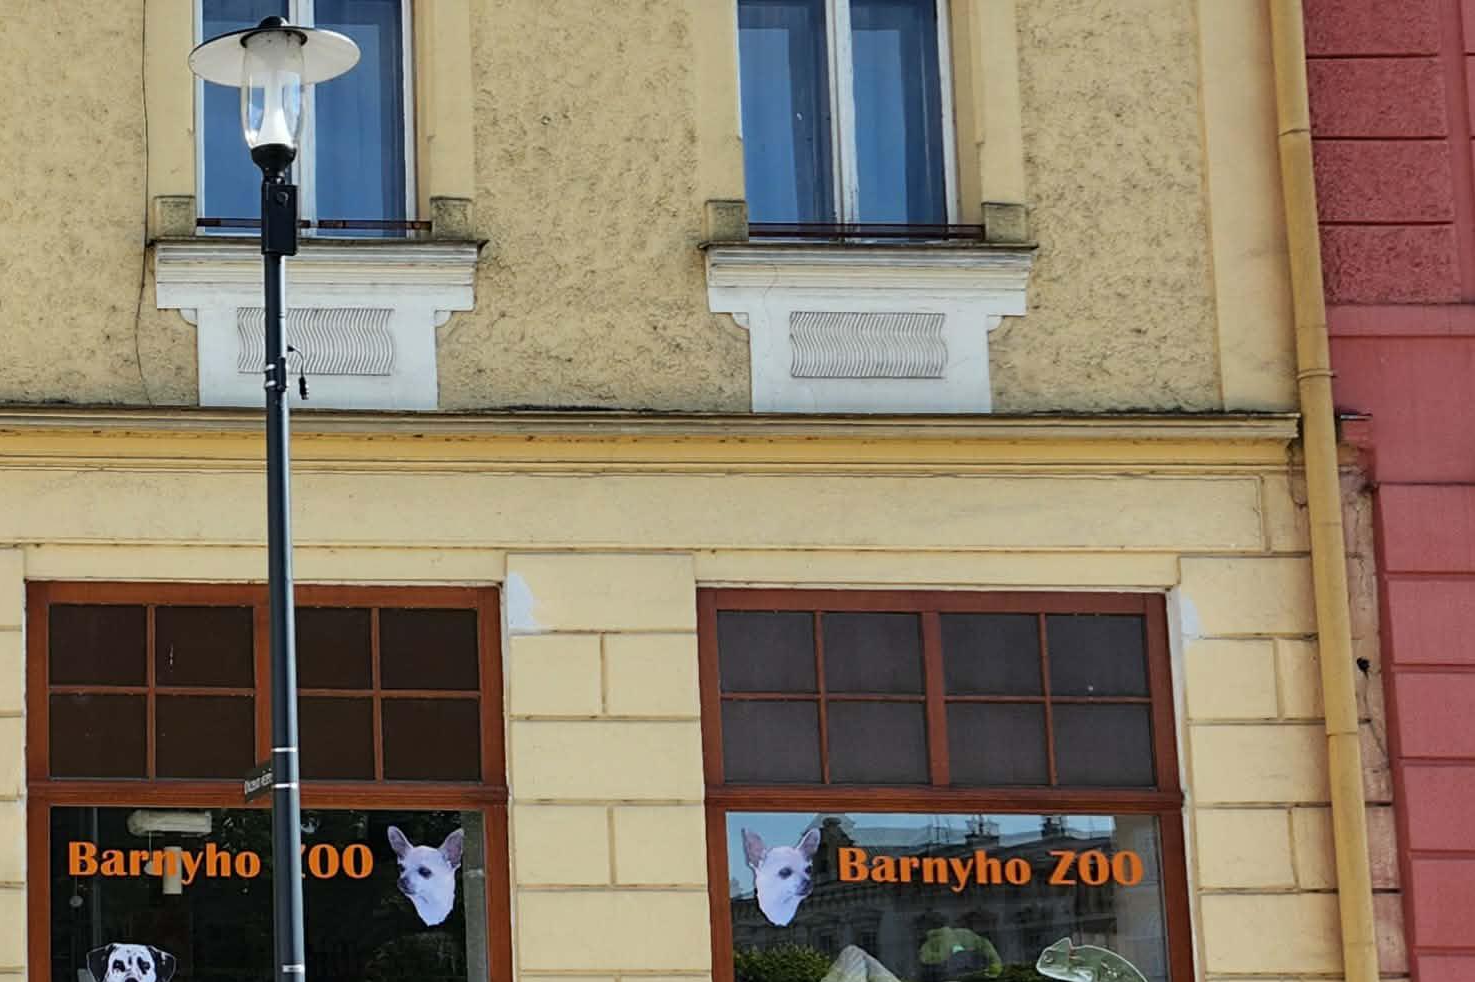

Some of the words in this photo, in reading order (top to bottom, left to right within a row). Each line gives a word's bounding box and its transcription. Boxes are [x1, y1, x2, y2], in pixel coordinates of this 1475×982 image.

[68, 841, 261, 885] Barnyho
[299, 843, 374, 879] OO
[838, 847, 1032, 893] Barnyho
[1048, 849, 1144, 886] ZOO
